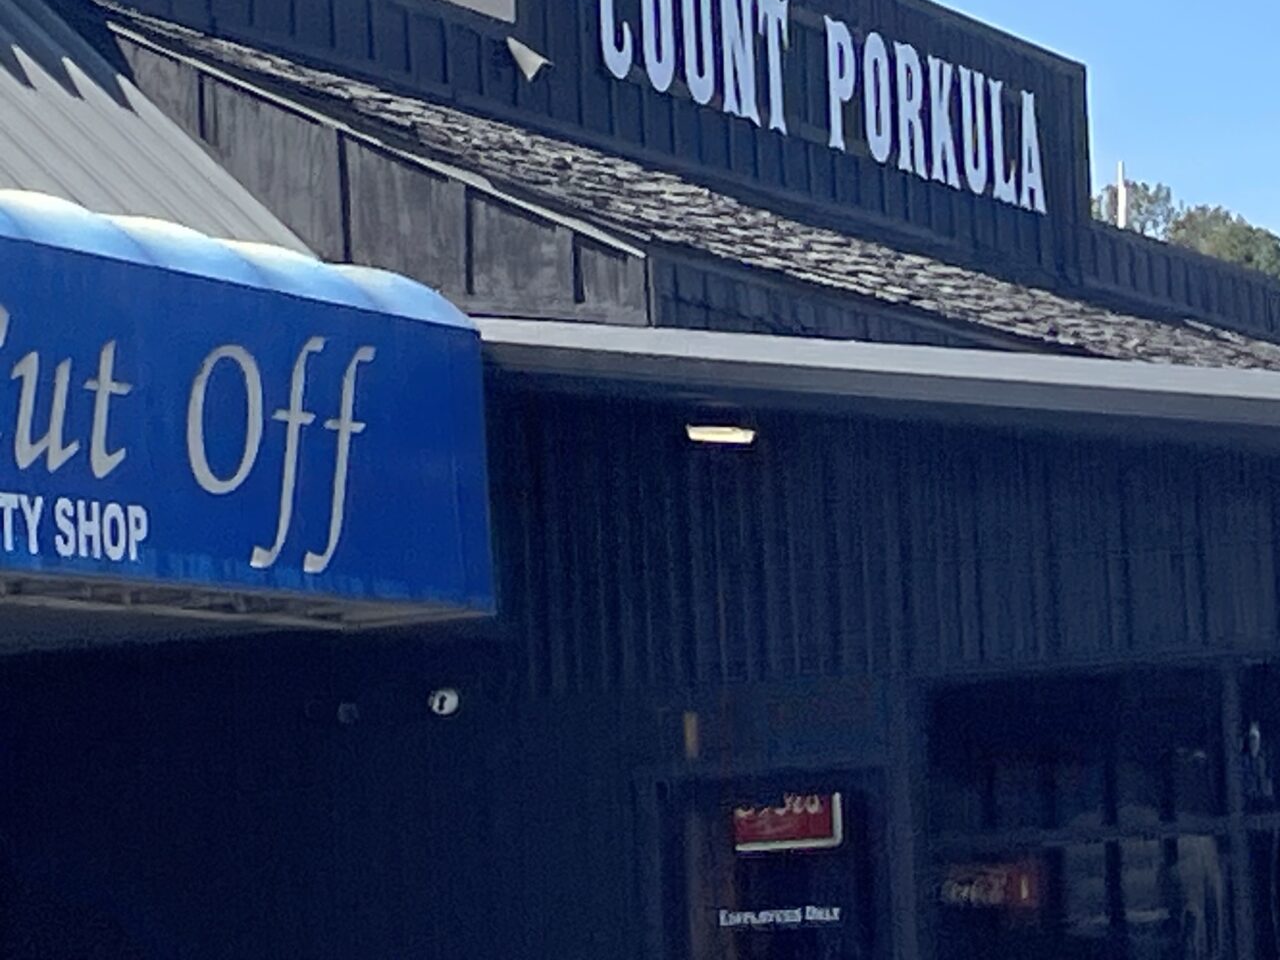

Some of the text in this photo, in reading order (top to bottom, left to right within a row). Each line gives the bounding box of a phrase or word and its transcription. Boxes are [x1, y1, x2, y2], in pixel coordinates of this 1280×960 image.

[823, 14, 1047, 215] PORKULA
[0, 304, 376, 574] ut Off
[0, 491, 148, 562] TY SHOP
